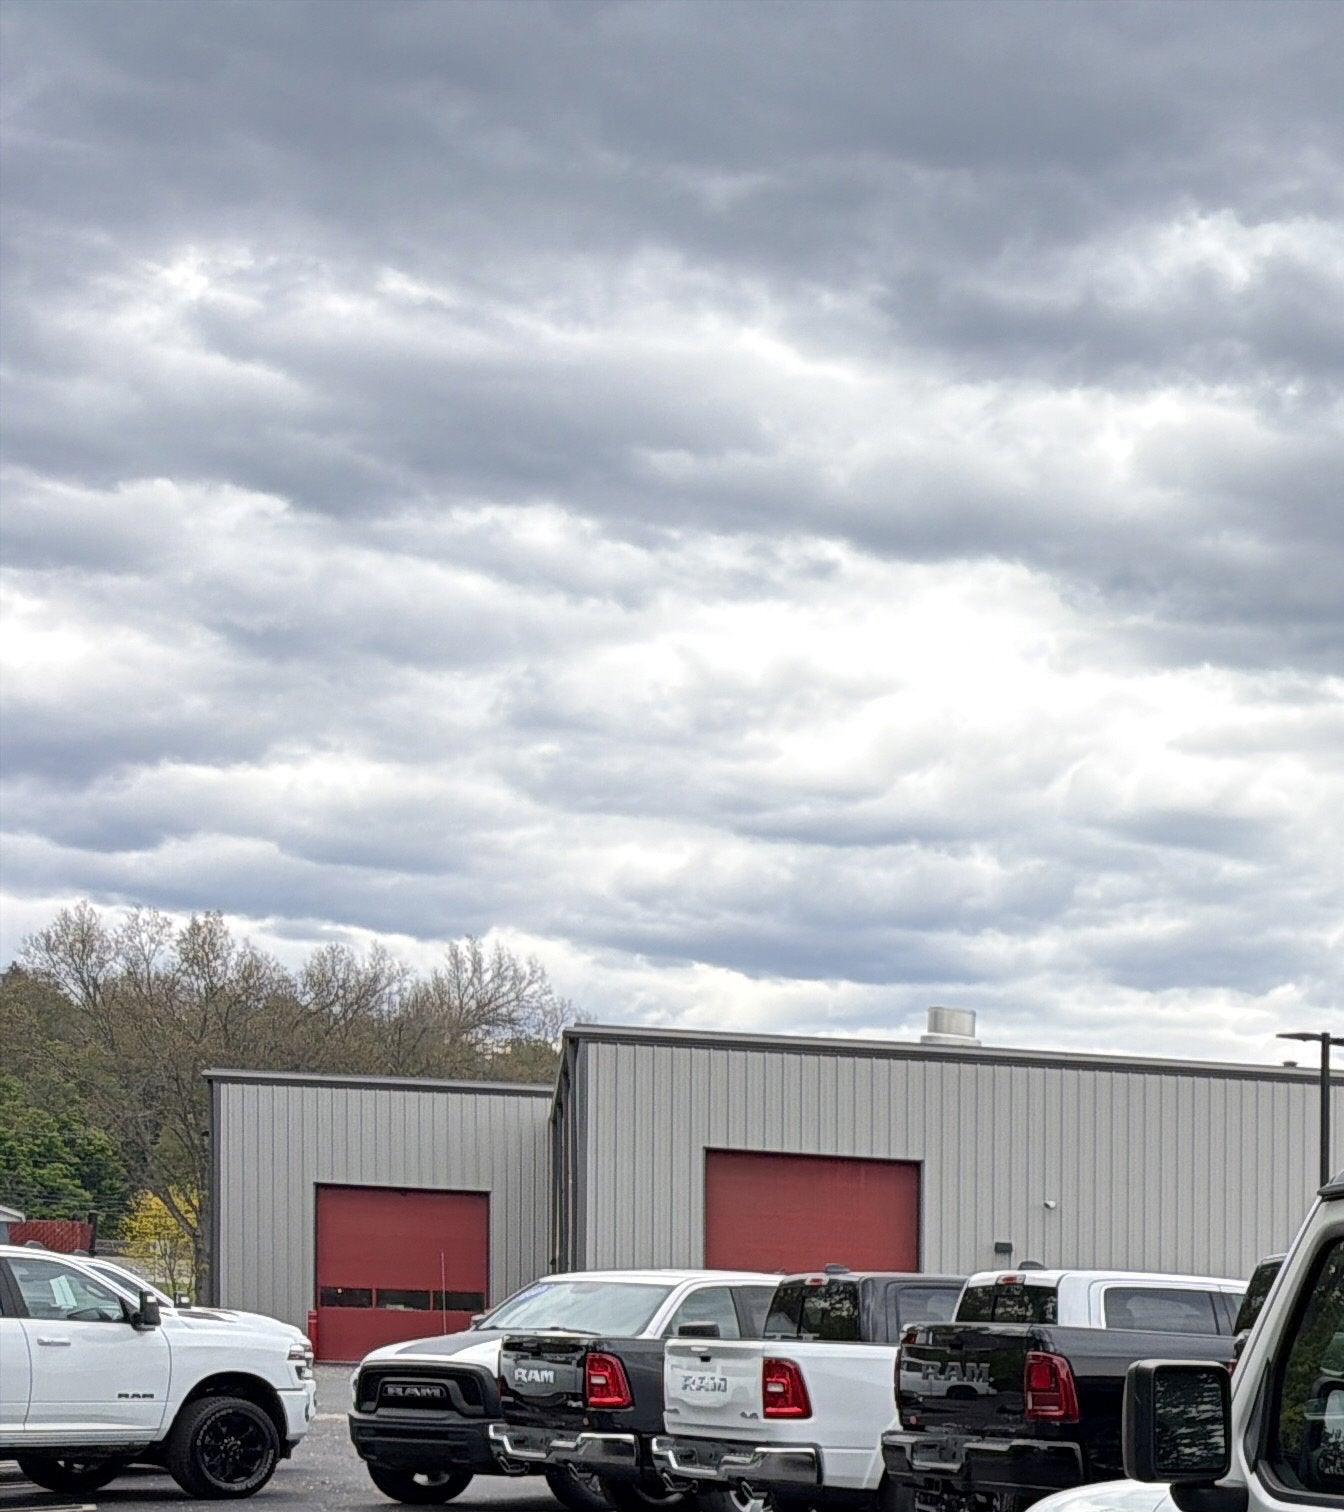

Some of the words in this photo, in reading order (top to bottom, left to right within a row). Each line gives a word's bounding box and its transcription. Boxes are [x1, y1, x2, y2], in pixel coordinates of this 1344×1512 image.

[514, 1368, 555, 1384] RAM
[922, 1361, 991, 1383] RAM
[387, 1385, 442, 1398] RAM
[681, 1375, 728, 1393] RAM
